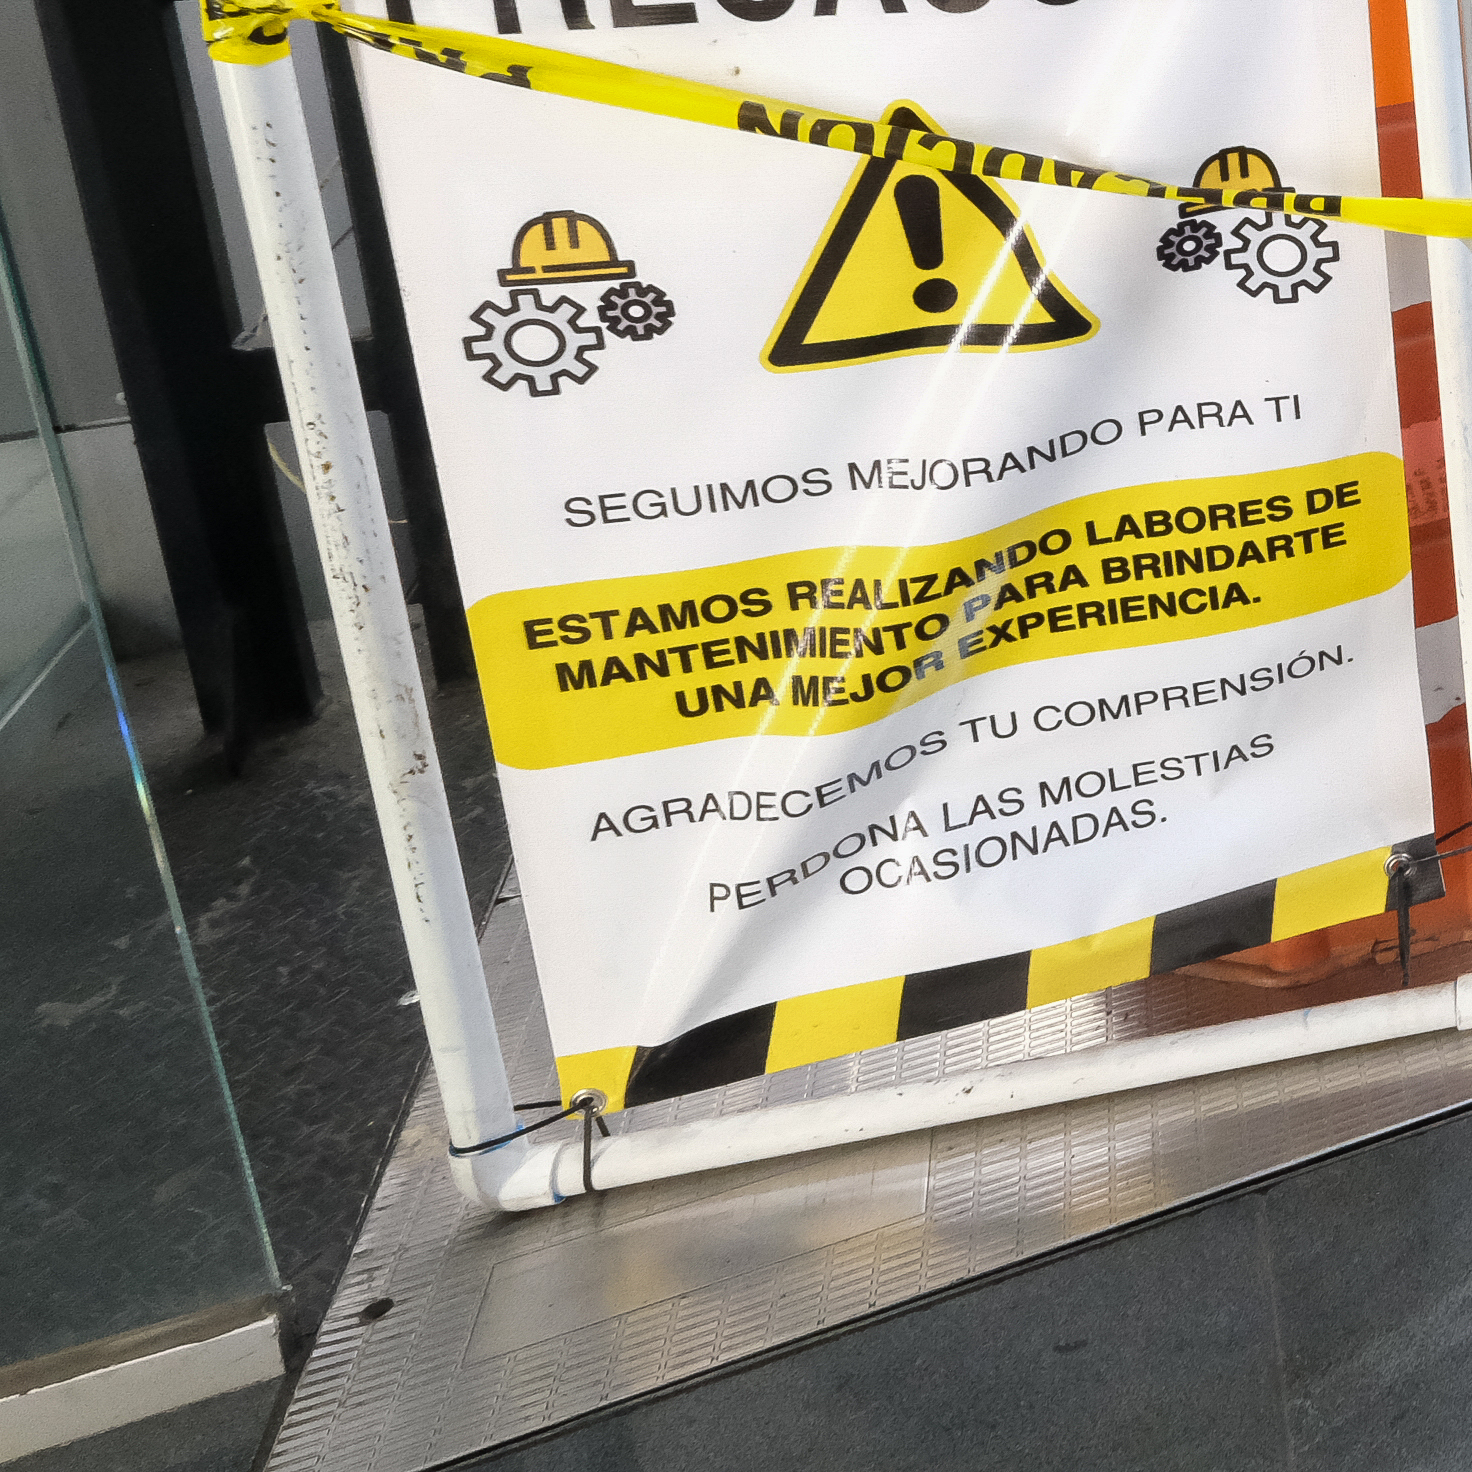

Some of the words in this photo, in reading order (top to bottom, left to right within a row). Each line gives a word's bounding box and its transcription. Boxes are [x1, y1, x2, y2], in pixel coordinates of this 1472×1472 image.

[563, 467, 833, 528] SEGUIMOS
[847, 418, 1123, 491] MEJORANDO
[1138, 399, 1254, 437] PARA
[1264, 394, 1302, 423] TI
[523, 586, 773, 650] ESTAMOS
[786, 529, 1072, 611] REALIZANDO
[1085, 495, 1293, 546] LABORES
[1306, 480, 1361, 516] DE
[555, 613, 950, 692] MANTENIMIENTO
[963, 564, 1090, 624] PARA
[1101, 521, 1347, 585] BRINDARTE
[675, 677, 780, 719] UNA
[792, 650, 944, 707] MEJOR
[958, 582, 1262, 660] EXPERIENCIA.
[590, 730, 948, 841] AGRADECEMOS
[959, 711, 1018, 742] TU
[1033, 644, 1354, 732] COMPRENSIÓN.
[709, 810, 929, 912] PERDONA
[942, 787, 1025, 832] LAS
[1039, 733, 1275, 808] MOLESTIAS
[839, 798, 1168, 895] OCASIONADAS.
